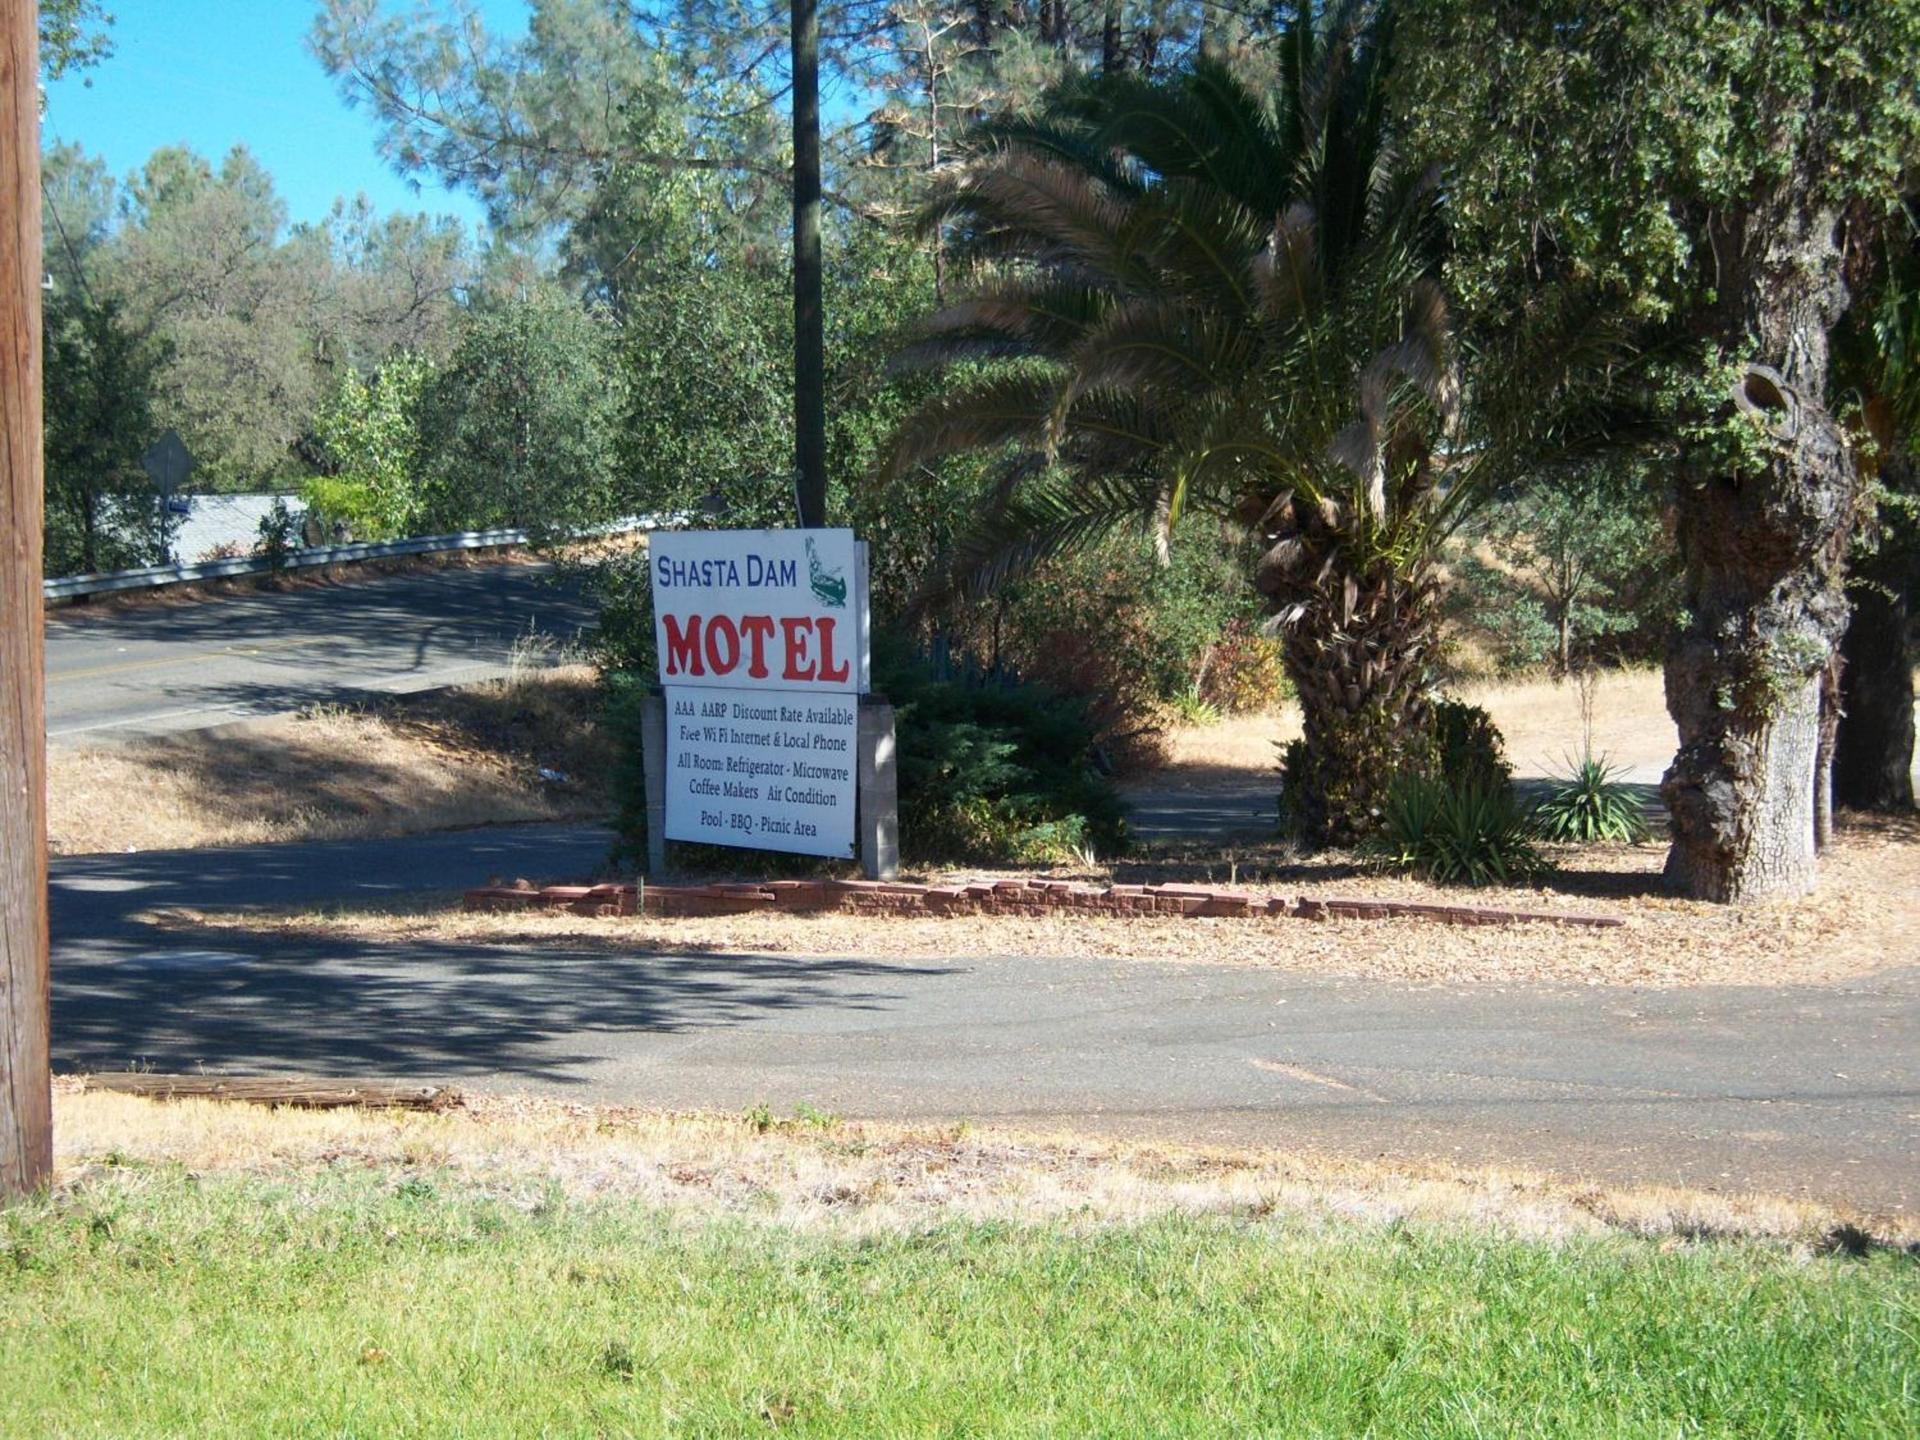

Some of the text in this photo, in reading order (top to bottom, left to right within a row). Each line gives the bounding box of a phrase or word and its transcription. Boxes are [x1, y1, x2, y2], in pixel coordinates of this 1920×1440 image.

[658, 554, 797, 587] SHASTA DAM
[662, 614, 849, 683] MOTEL
[674, 700, 853, 725] AAA AARP Discount Rate Available
[680, 725, 700, 741] Free
[730, 729, 770, 746] Internet
[773, 732, 781, 747] &
[784, 732, 810, 749] Local
[813, 734, 847, 752] Phone
[677, 753, 691, 768] All
[726, 756, 784, 778] Refrigerator
[793, 761, 849, 781] Microwave
[689, 778, 837, 806] Coffee Makers Air Condition
[700, 810, 722, 827] Pool
[730, 813, 752, 835] BBQ
[760, 815, 791, 834] Picnic
[793, 819, 817, 836] Area
